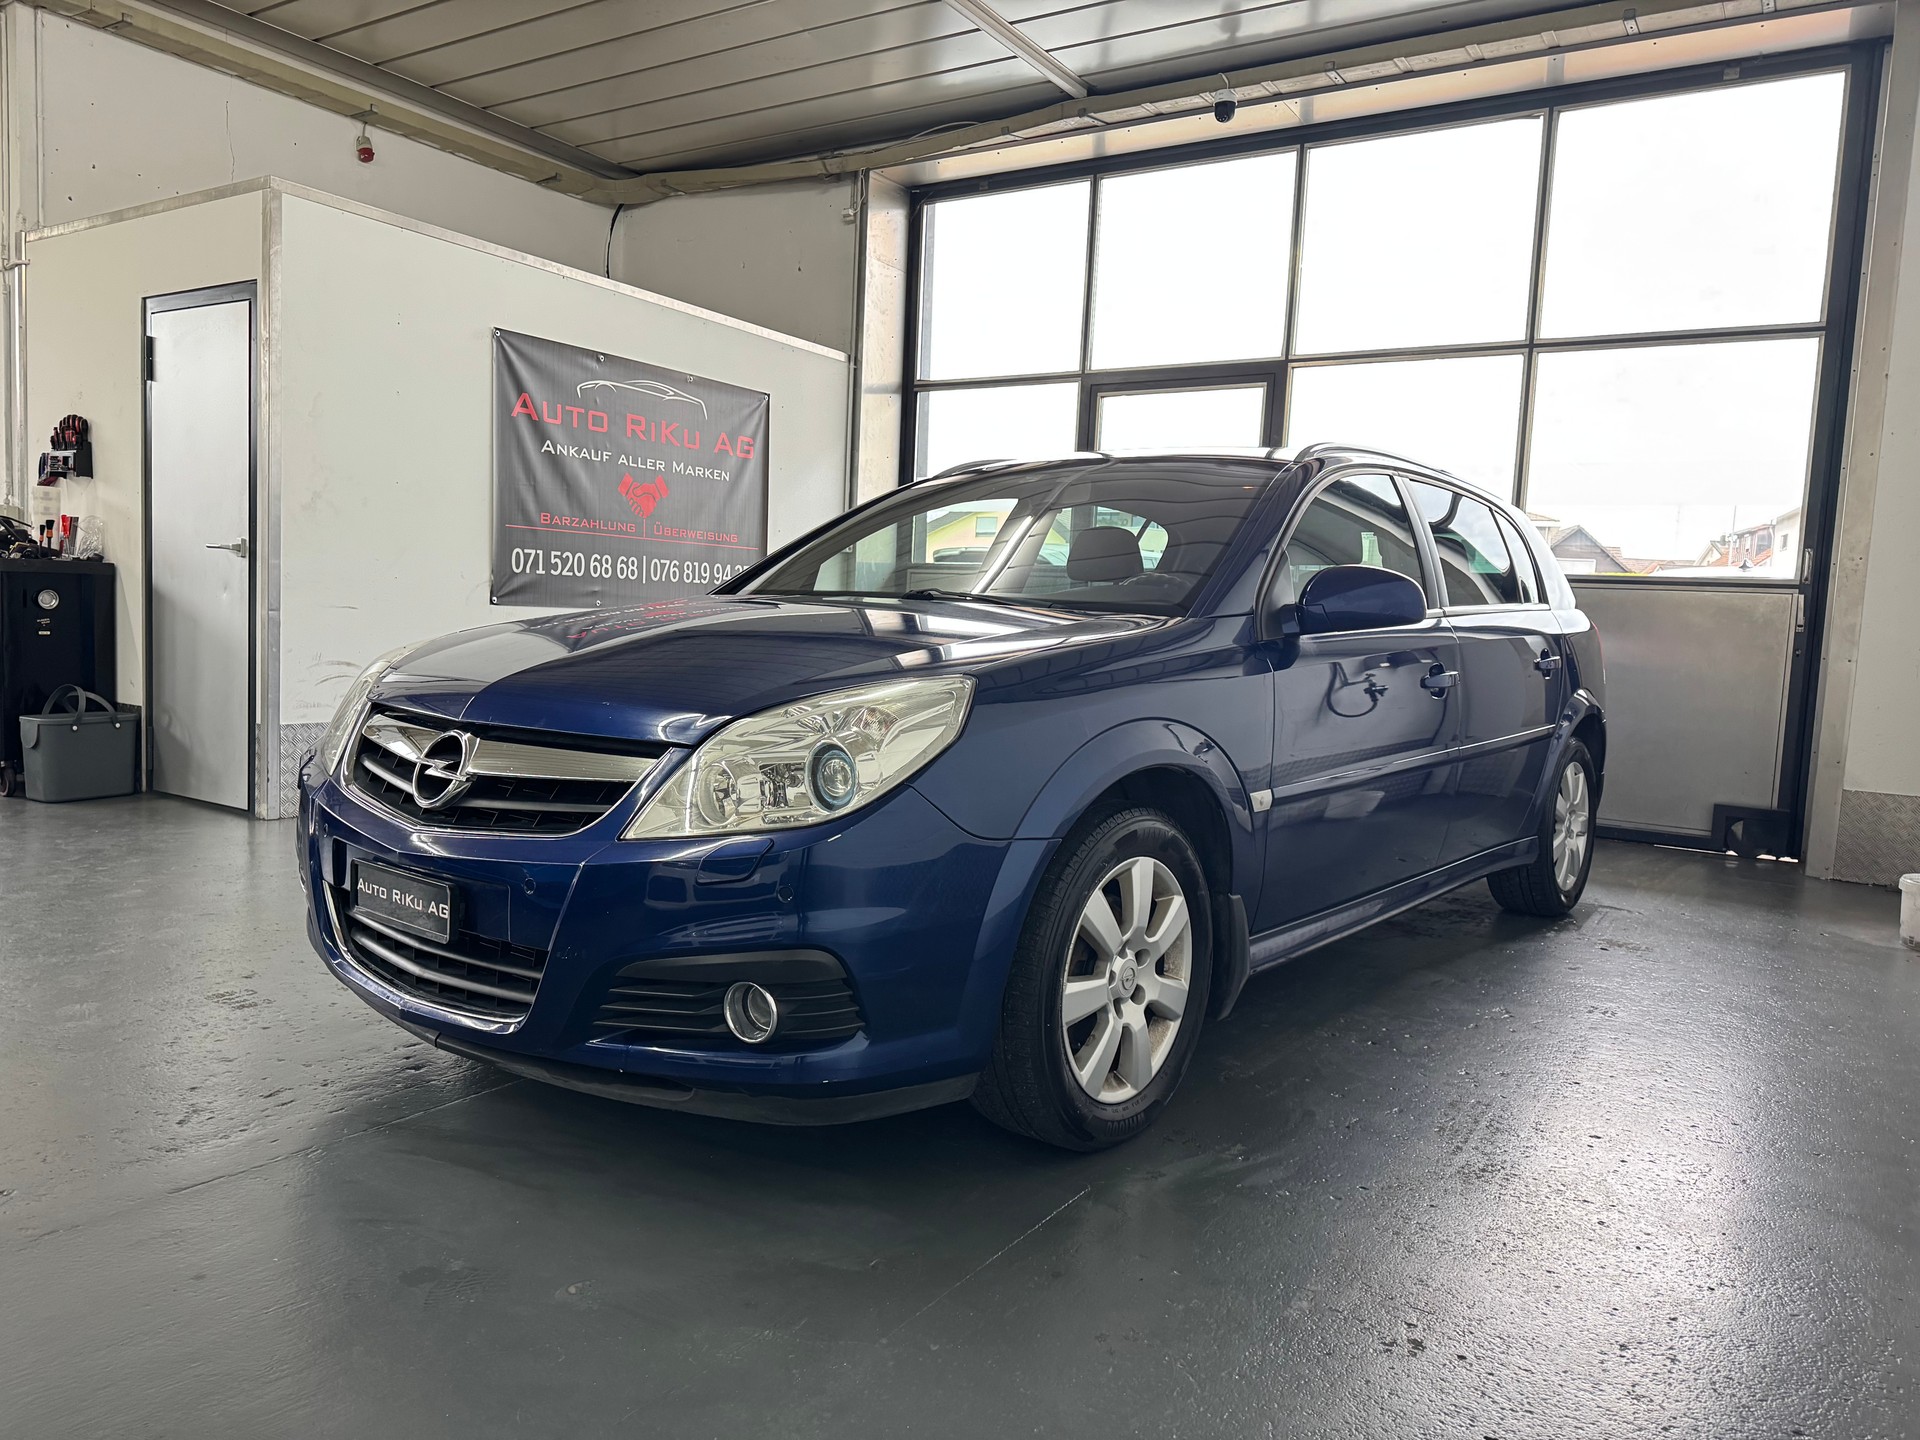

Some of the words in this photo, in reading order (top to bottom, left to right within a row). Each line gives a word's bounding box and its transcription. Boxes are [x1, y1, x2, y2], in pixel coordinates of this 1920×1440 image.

[511, 392, 609, 433] AUTO
[713, 432, 754, 459] AG
[541, 440, 612, 463] ANKAUF
[618, 454, 666, 472] ALLER
[672, 461, 730, 482] MARKEN
[540, 512, 636, 533] BARZAHLUNG
[653, 521, 739, 543] ÜBERWEISUNG
[511, 548, 546, 575] 071
[550, 551, 585, 576] 520
[589, 554, 612, 577] 68
[616, 556, 638, 580] 68
[650, 558, 680, 581] 076
[684, 561, 710, 585] 819
[713, 562, 732, 585] 94
[357, 878, 387, 899] AUTO
[427, 901, 449, 919] AG
